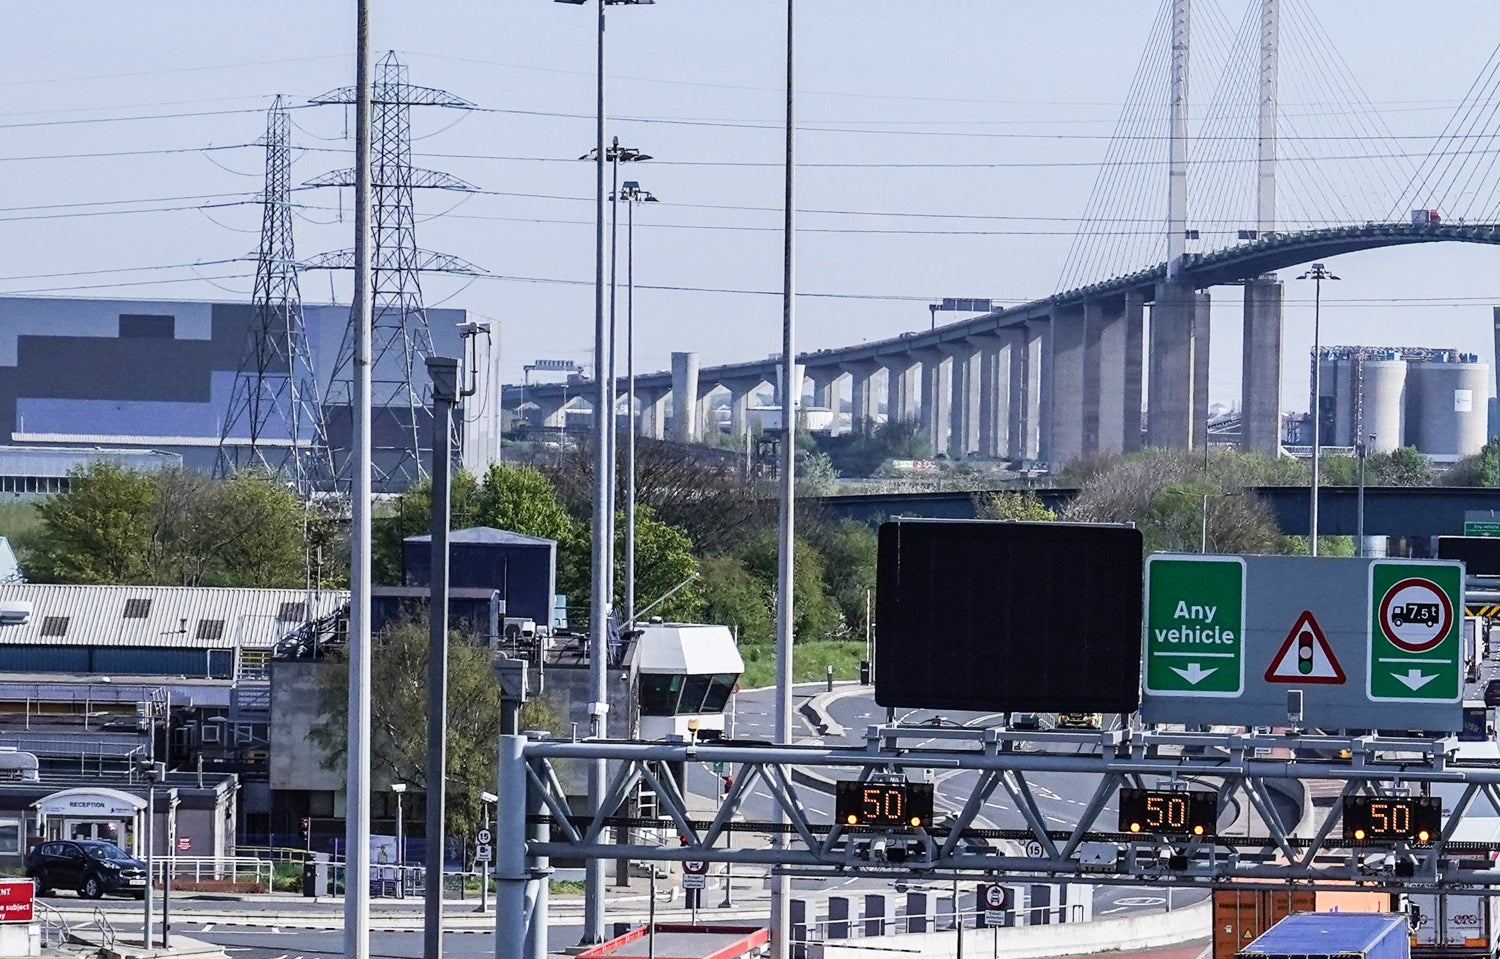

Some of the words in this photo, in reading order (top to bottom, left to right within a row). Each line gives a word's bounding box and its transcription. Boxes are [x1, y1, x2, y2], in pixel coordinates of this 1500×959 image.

[1173, 600, 1217, 623] Any
[1154, 626, 1235, 645] vehicle
[863, 789, 902, 819] 50
[1146, 797, 1186, 827] 50
[1371, 804, 1409, 833] 50
[1030, 846, 1040, 854] 15
[0, 888, 11, 896] NT
[6, 903, 30, 912] subject
